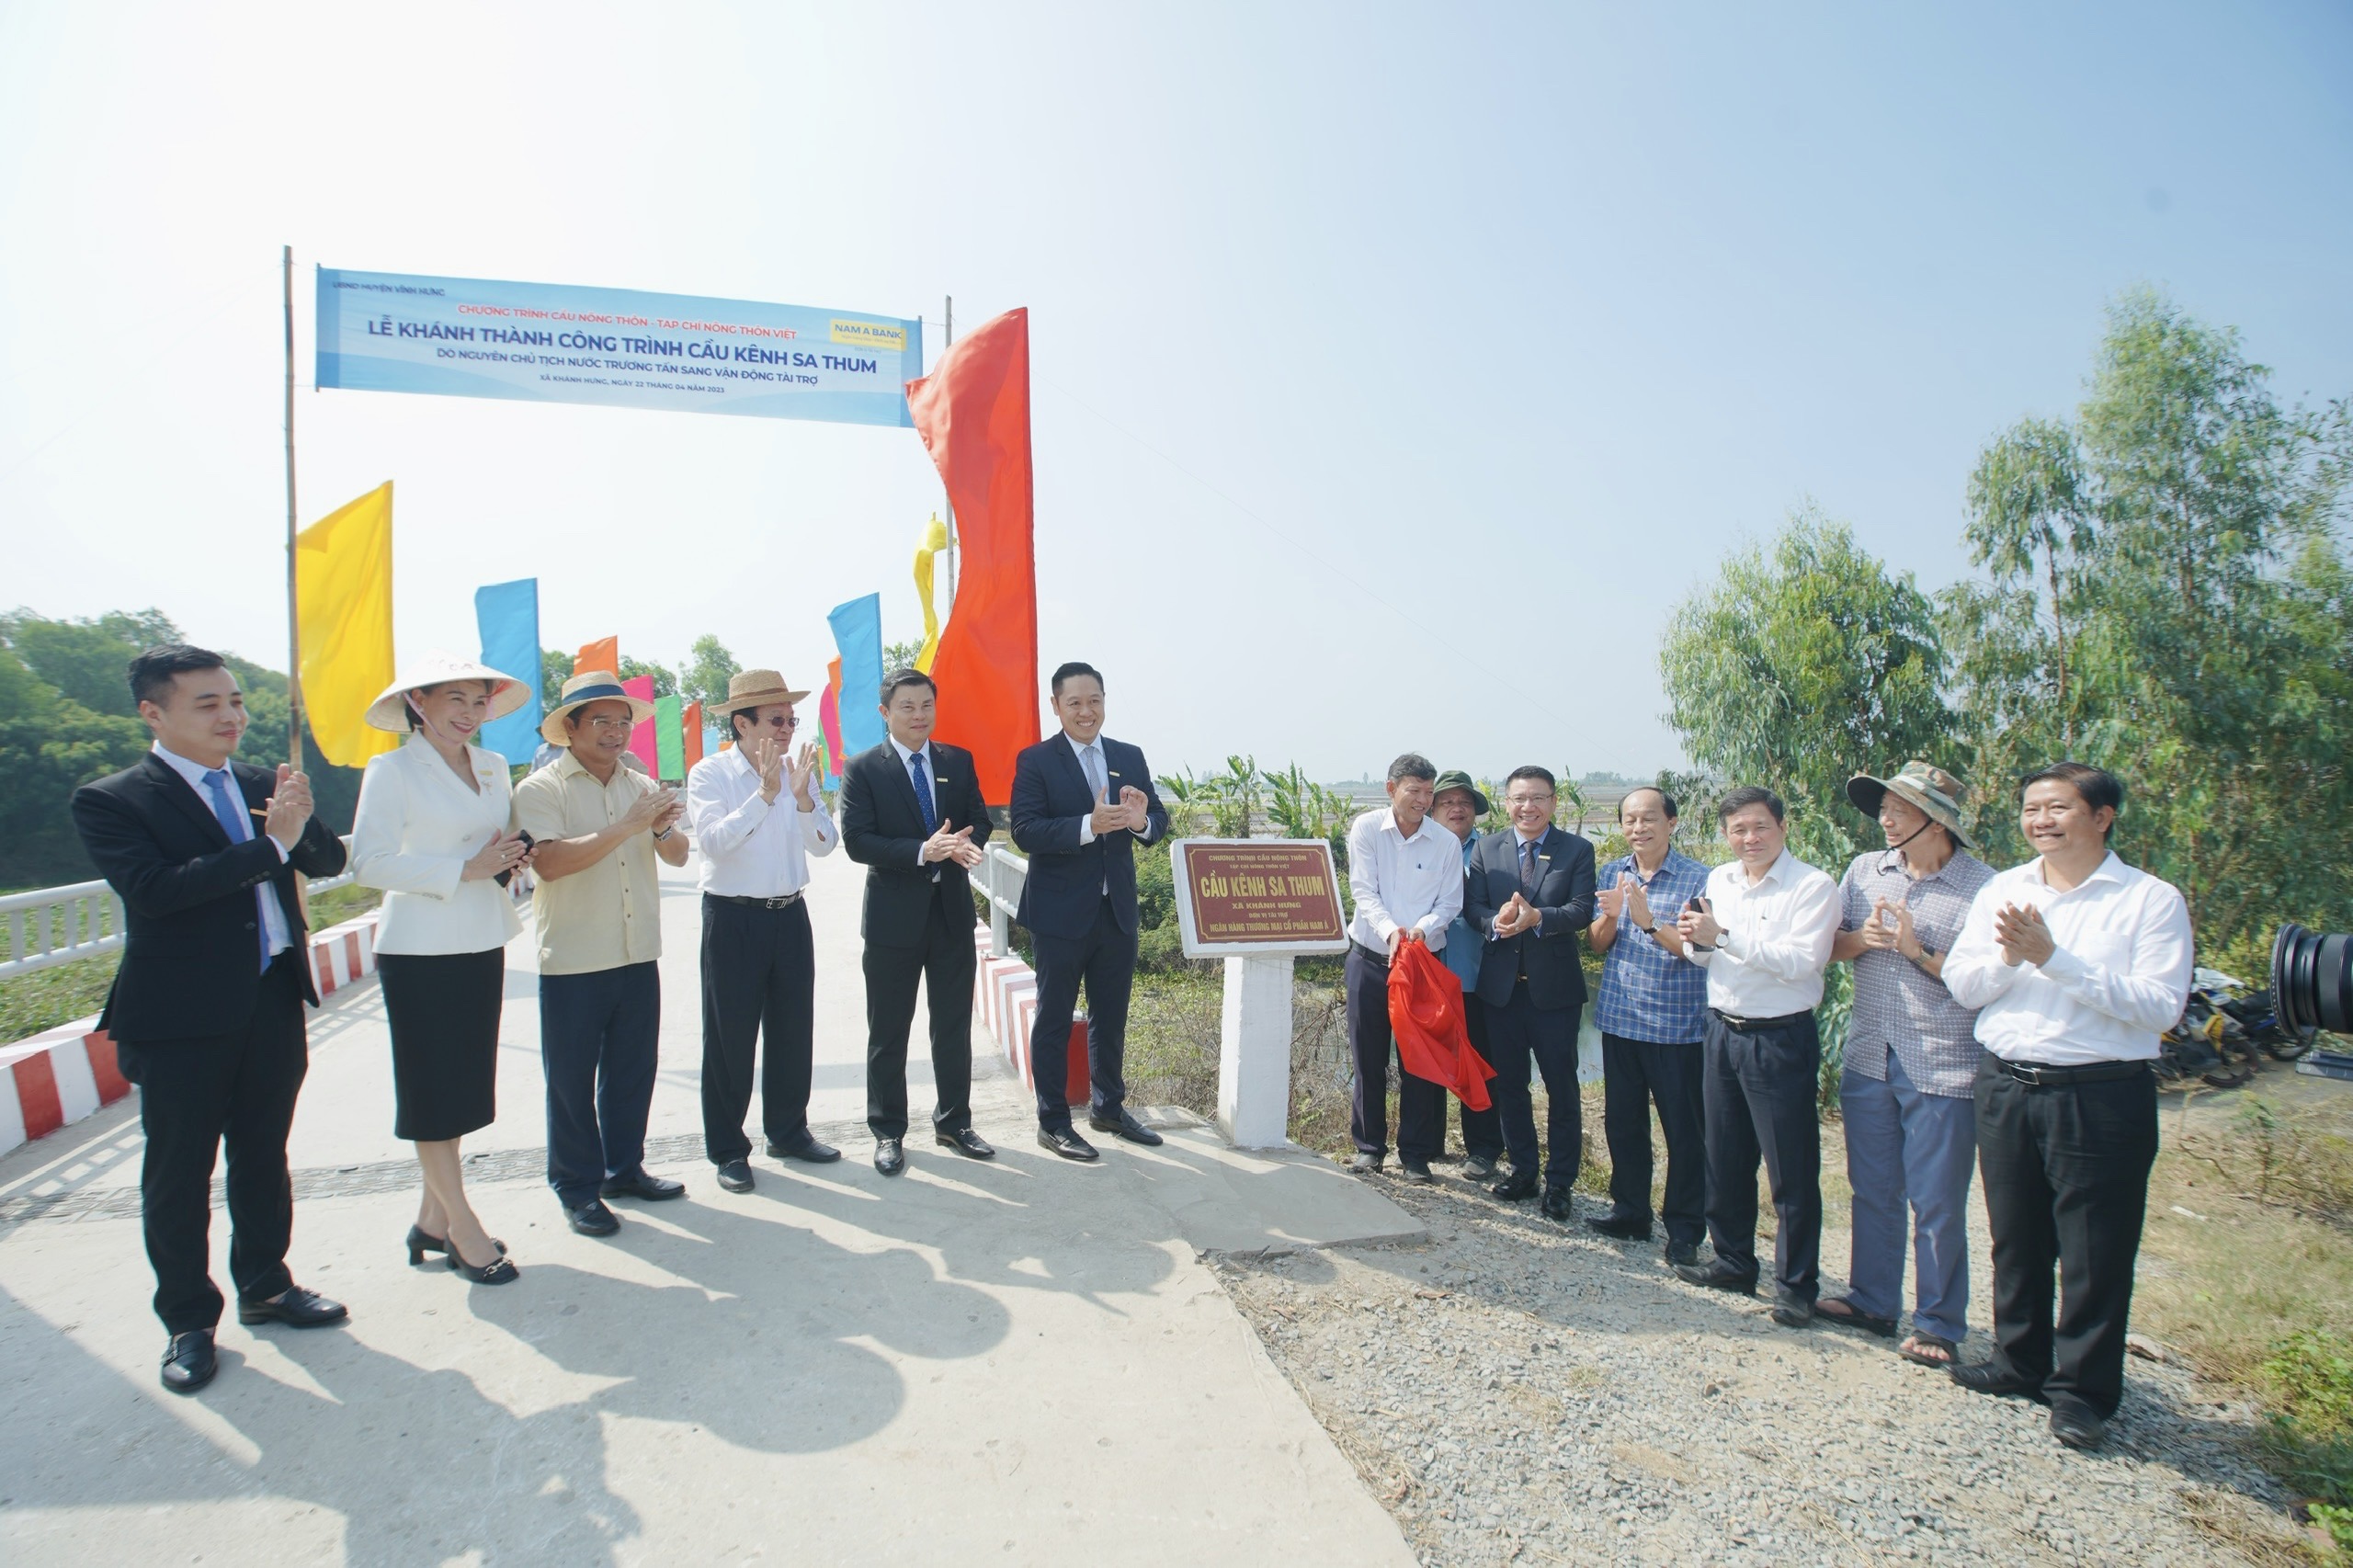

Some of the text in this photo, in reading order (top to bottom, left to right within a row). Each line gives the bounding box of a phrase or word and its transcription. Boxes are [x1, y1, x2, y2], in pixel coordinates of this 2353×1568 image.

[703, 322, 737, 335] NÔNG
[739, 324, 771, 337] THÔN
[835, 324, 860, 334] NAM
[872, 329, 902, 339] BANK
[368, 314, 877, 374] LỄ KHÁNH THÀNH CÔNG TRÌNH CẦU KÊNH SA THUM
[537, 356, 565, 368] TỊCH
[681, 366, 712, 376] SANG
[714, 367, 738, 381] VẬN
[777, 373, 793, 383] TÀI
[796, 374, 818, 386] TRỢ
[552, 374, 582, 383] KHÁNH
[645, 381, 674, 390] THÁNG
[1200, 869, 1325, 899] CẦU KÊNH SA THUM
[1310, 921, 1324, 929] NAM
